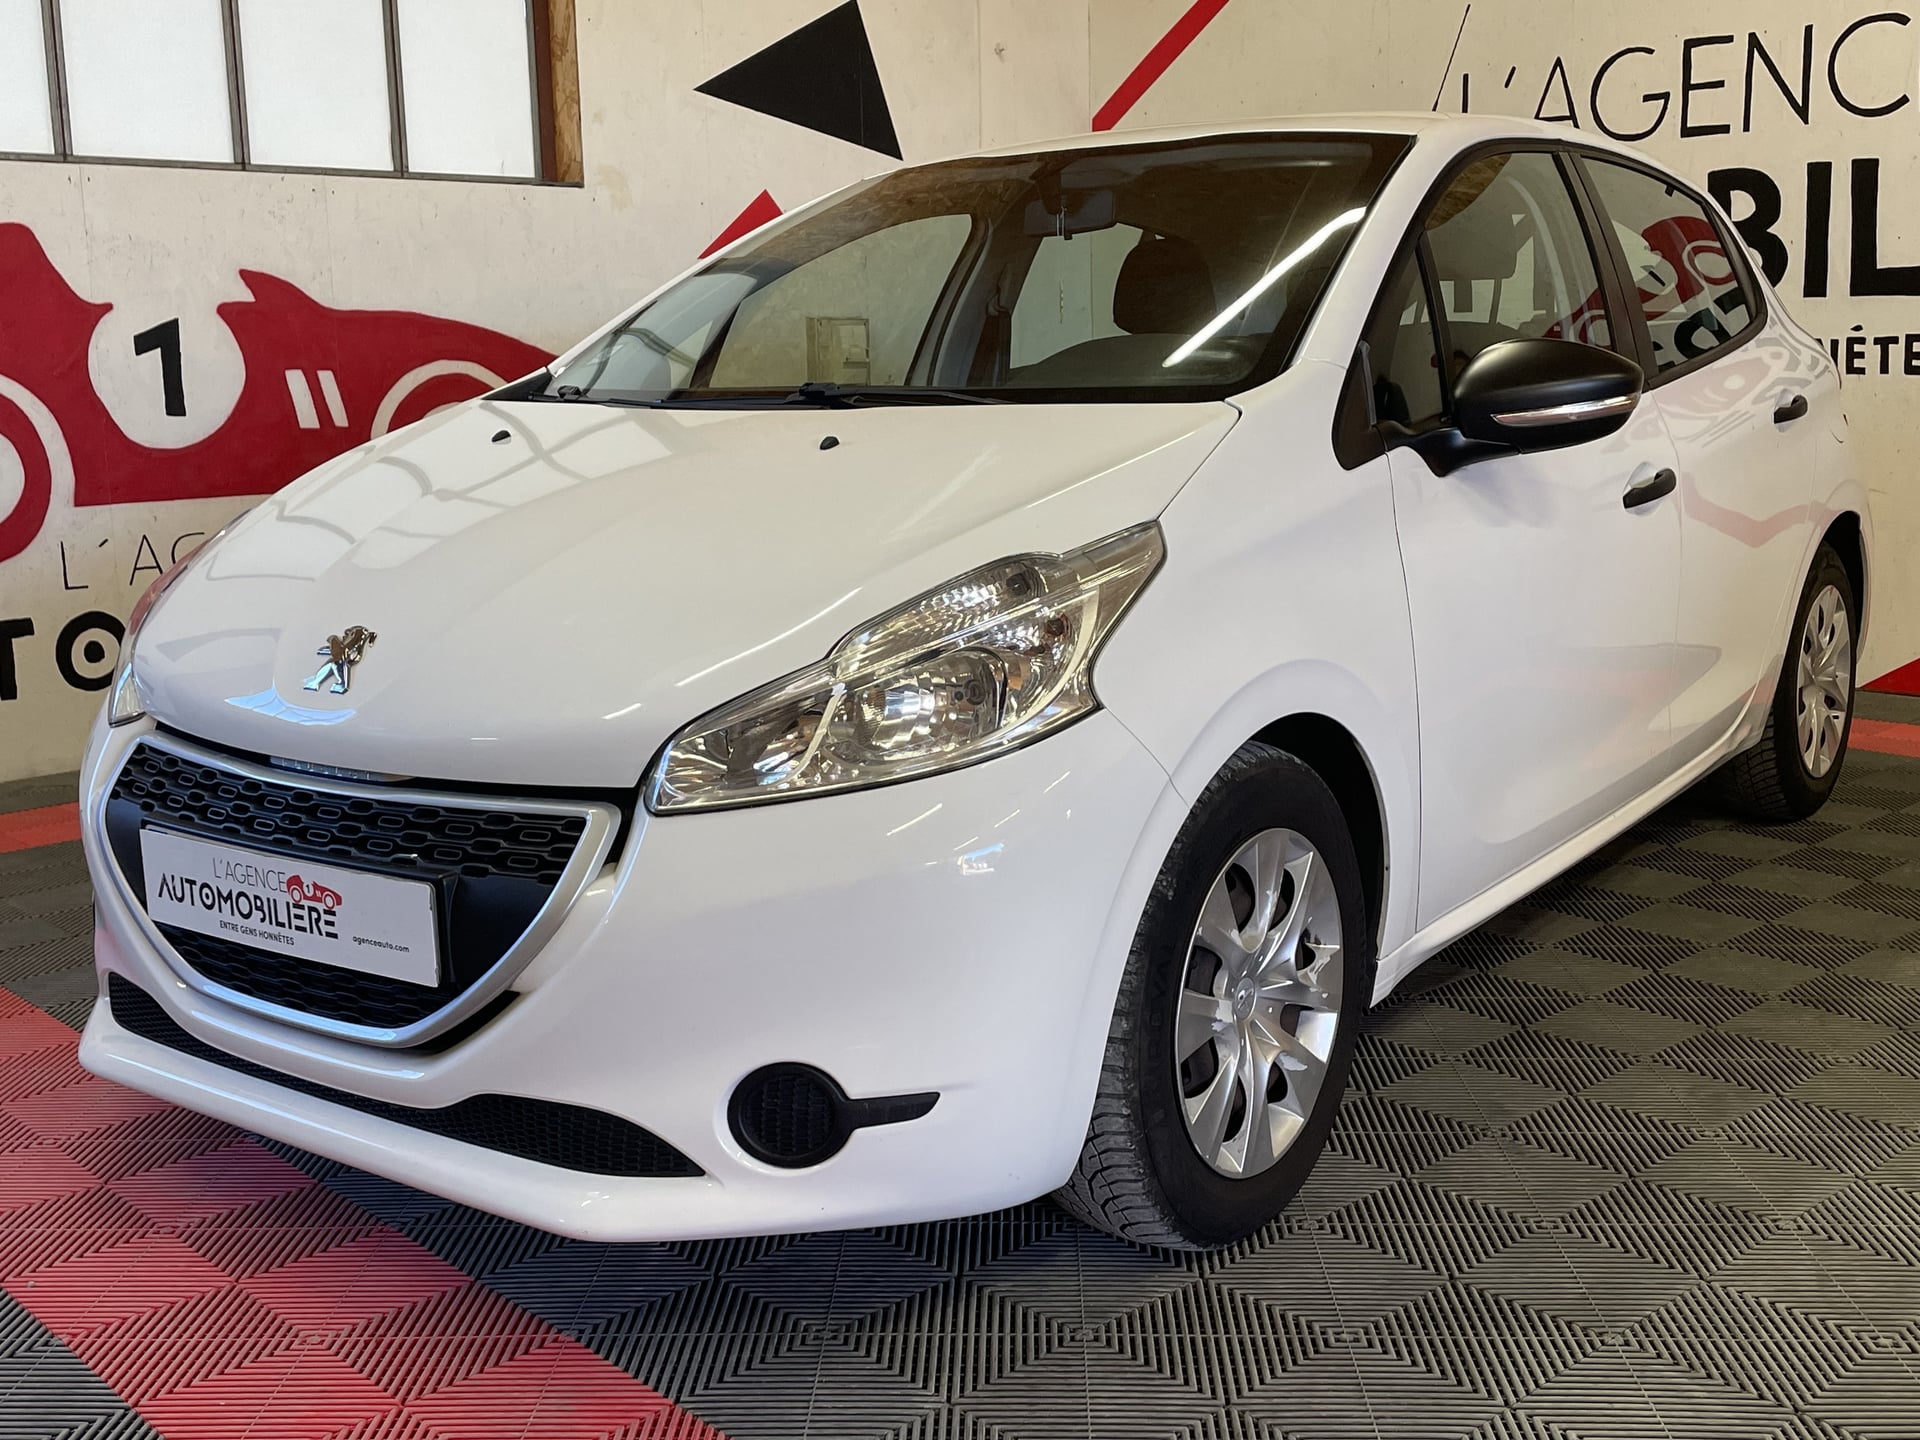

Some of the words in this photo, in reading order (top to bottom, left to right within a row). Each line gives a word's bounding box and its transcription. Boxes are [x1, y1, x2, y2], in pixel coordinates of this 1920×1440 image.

[133, 317, 187, 417] 1
[212, 857, 288, 893] L'AGENCE
[219, 919, 239, 932] ENTRE
[240, 925, 257, 936] GENS
[352, 936, 410, 953] agenceauto.com
